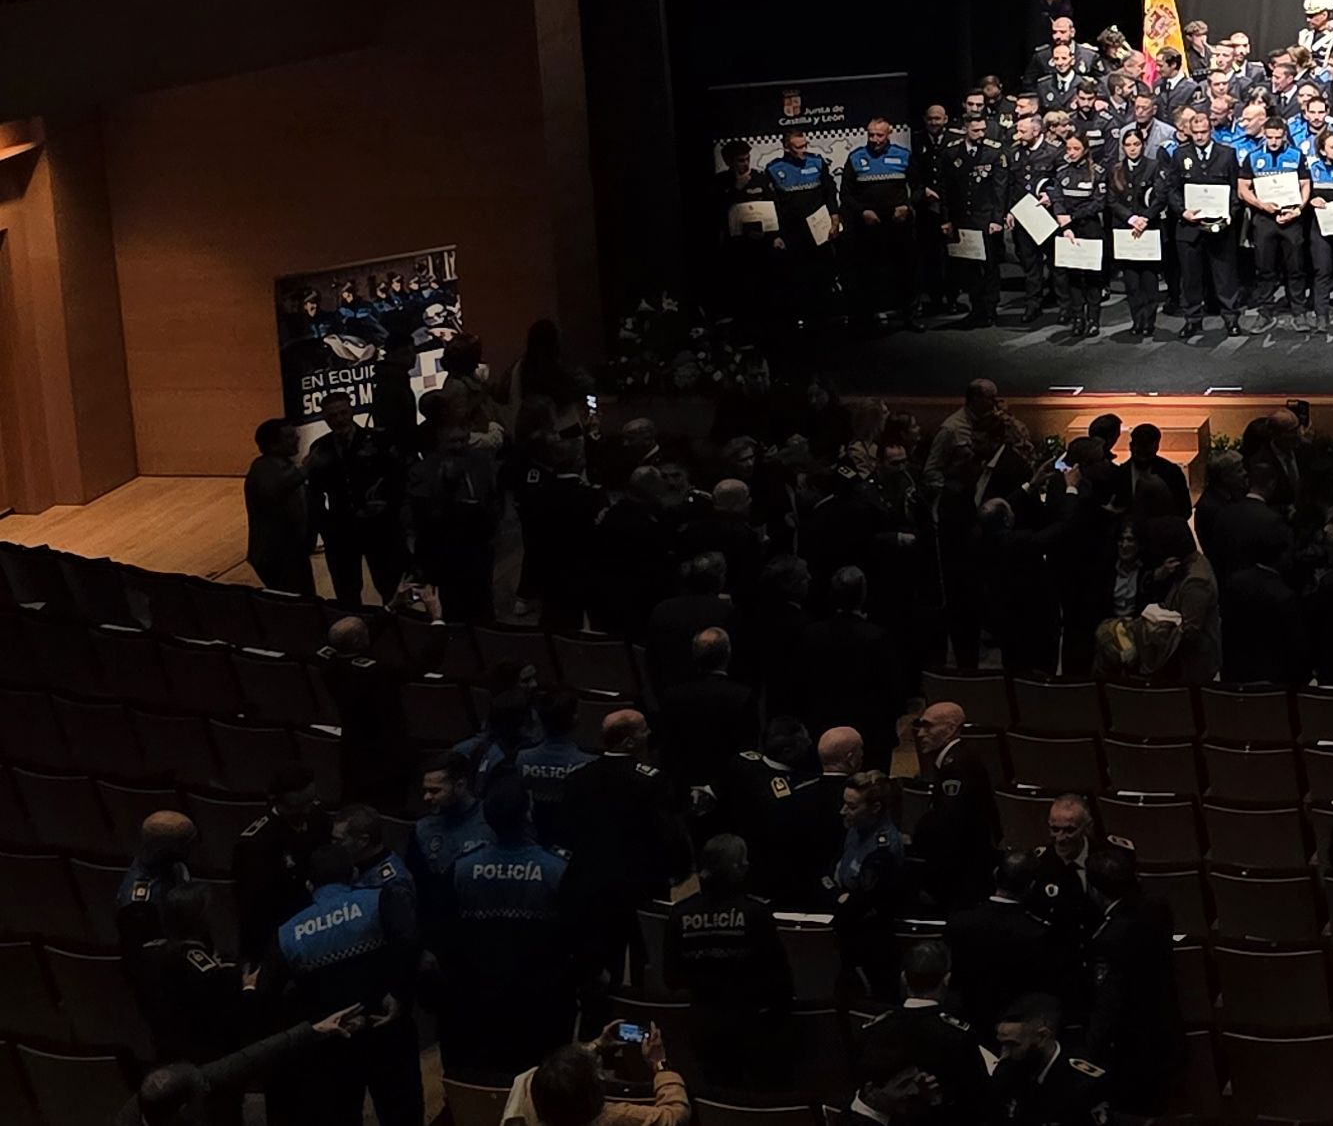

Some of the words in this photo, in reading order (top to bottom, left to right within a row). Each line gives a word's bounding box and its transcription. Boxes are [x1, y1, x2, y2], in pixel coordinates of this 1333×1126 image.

[302, 375, 325, 390] EN
[329, 364, 376, 384] EQUIP
[472, 860, 543, 881] POLICÍA
[294, 901, 363, 941] POLICÍA
[681, 907, 746, 930] POLICÍA
